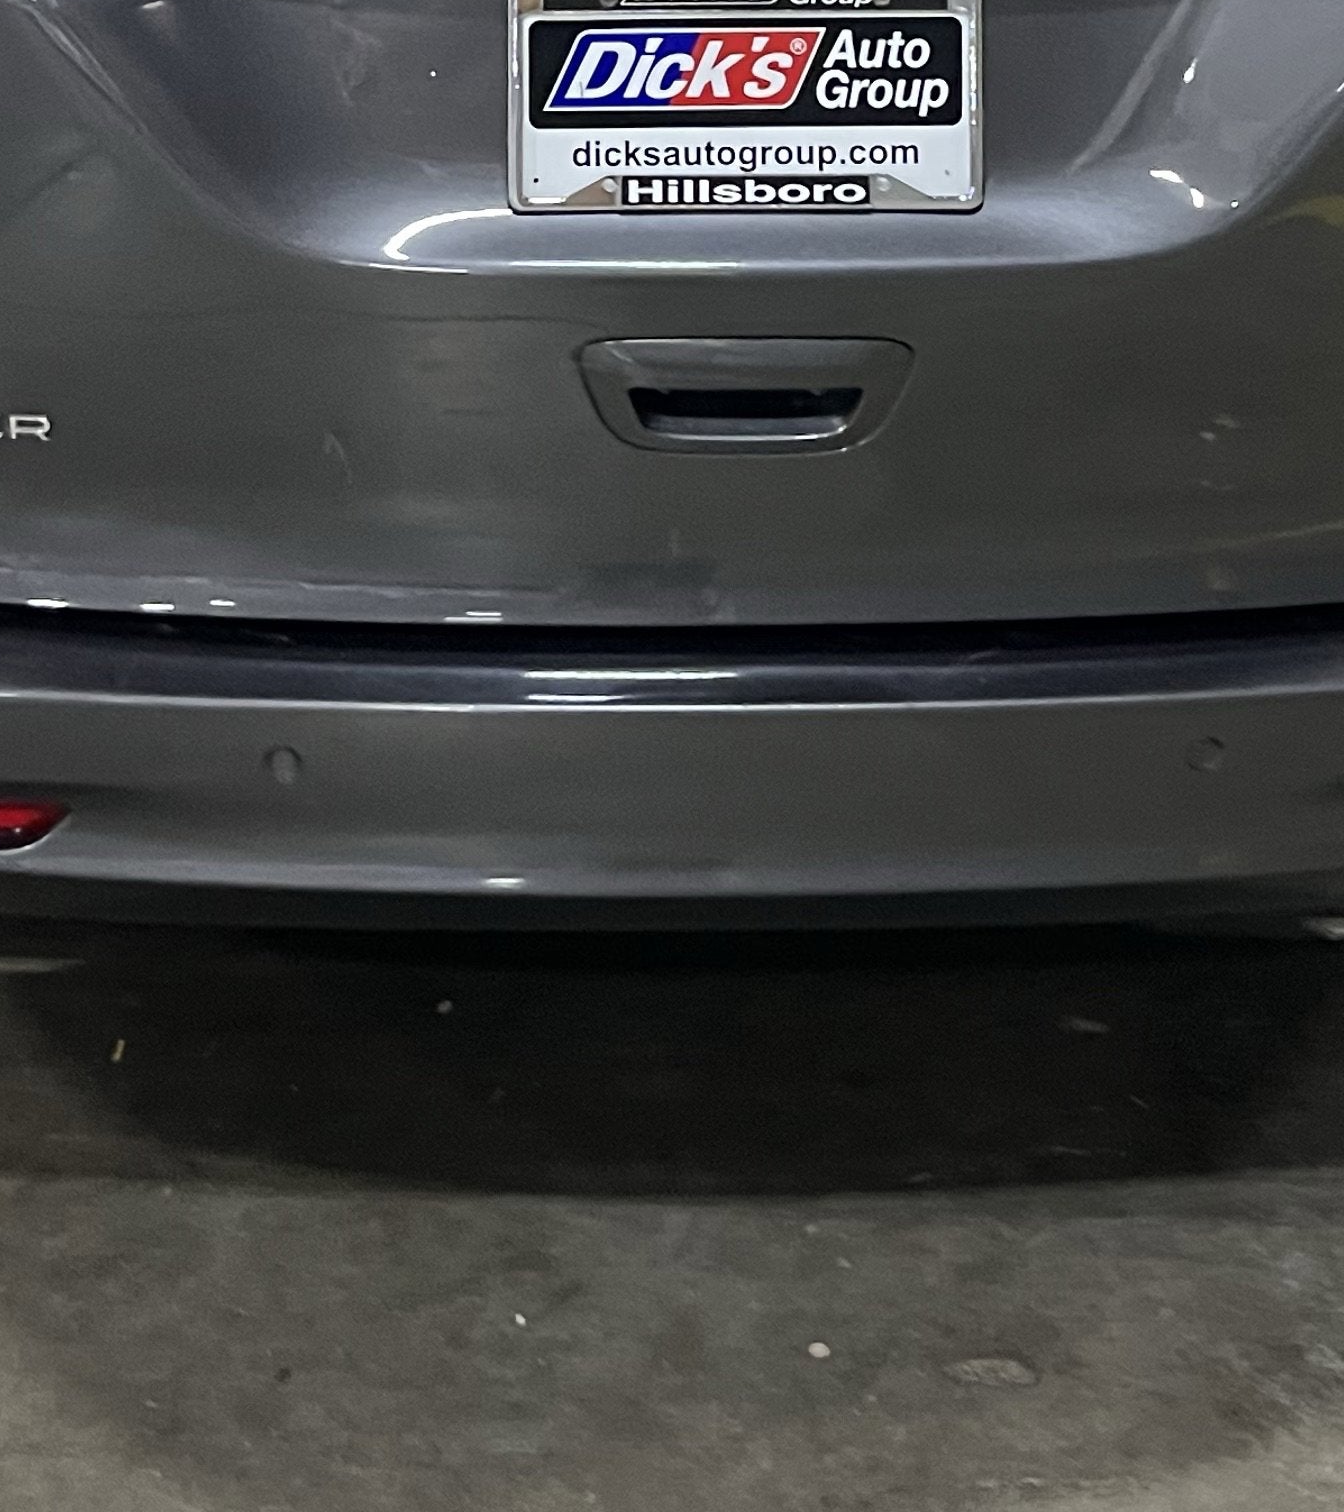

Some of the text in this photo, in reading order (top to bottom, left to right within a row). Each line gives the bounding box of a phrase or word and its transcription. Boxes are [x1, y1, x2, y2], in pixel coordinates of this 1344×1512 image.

[563, 36, 793, 100] Dick's
[823, 29, 931, 69] Auto
[816, 69, 949, 117] Group
[572, 140, 920, 172] dicksautogroup.com
[627, 178, 867, 206] Hillsboro
